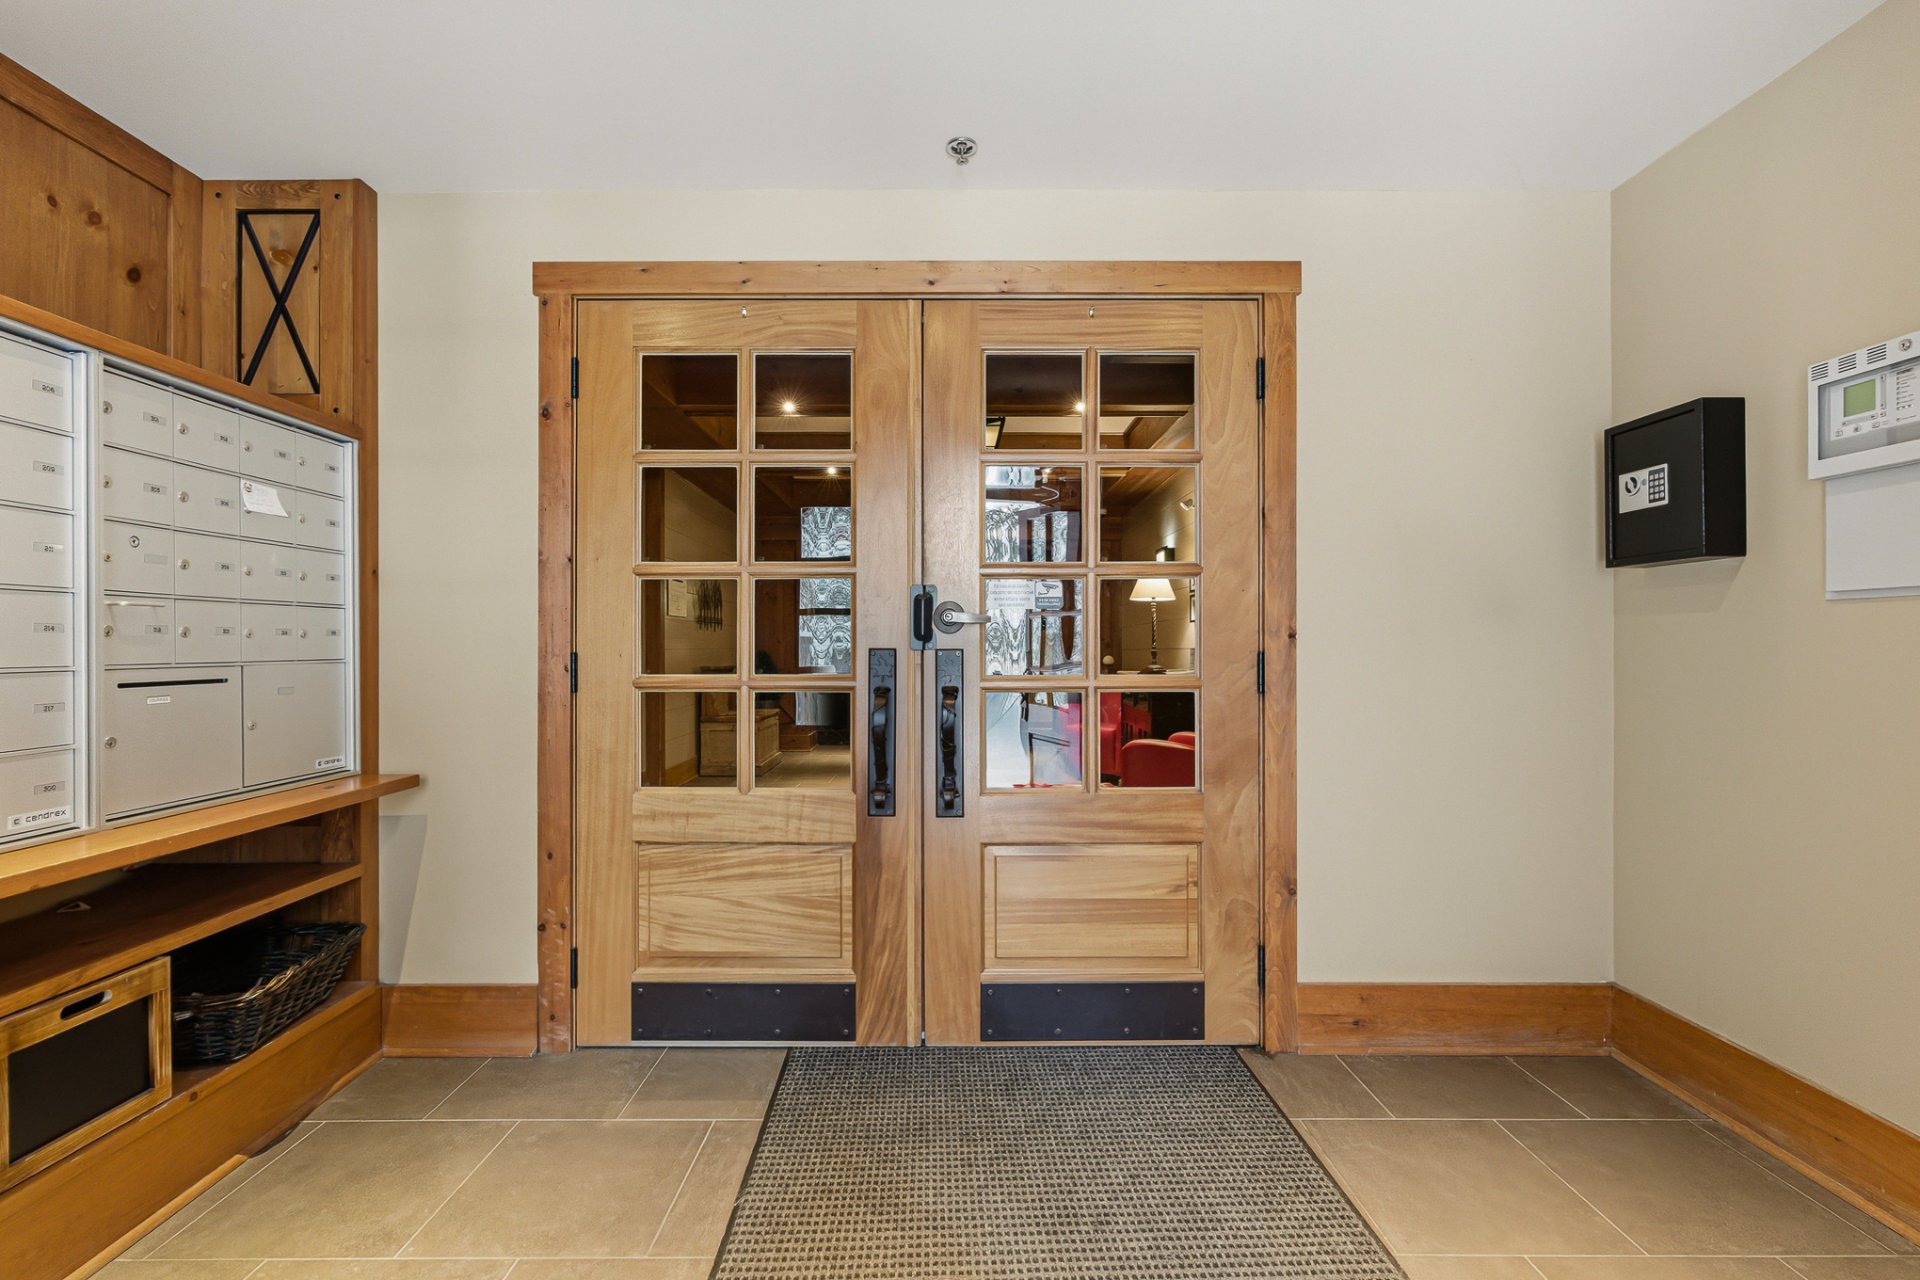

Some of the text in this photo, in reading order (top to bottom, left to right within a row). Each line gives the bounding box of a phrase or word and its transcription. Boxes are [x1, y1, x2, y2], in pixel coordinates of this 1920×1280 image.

[43, 705, 54, 713] 217
[43, 784, 57, 793] 300
[25, 809, 67, 823] cendrex
